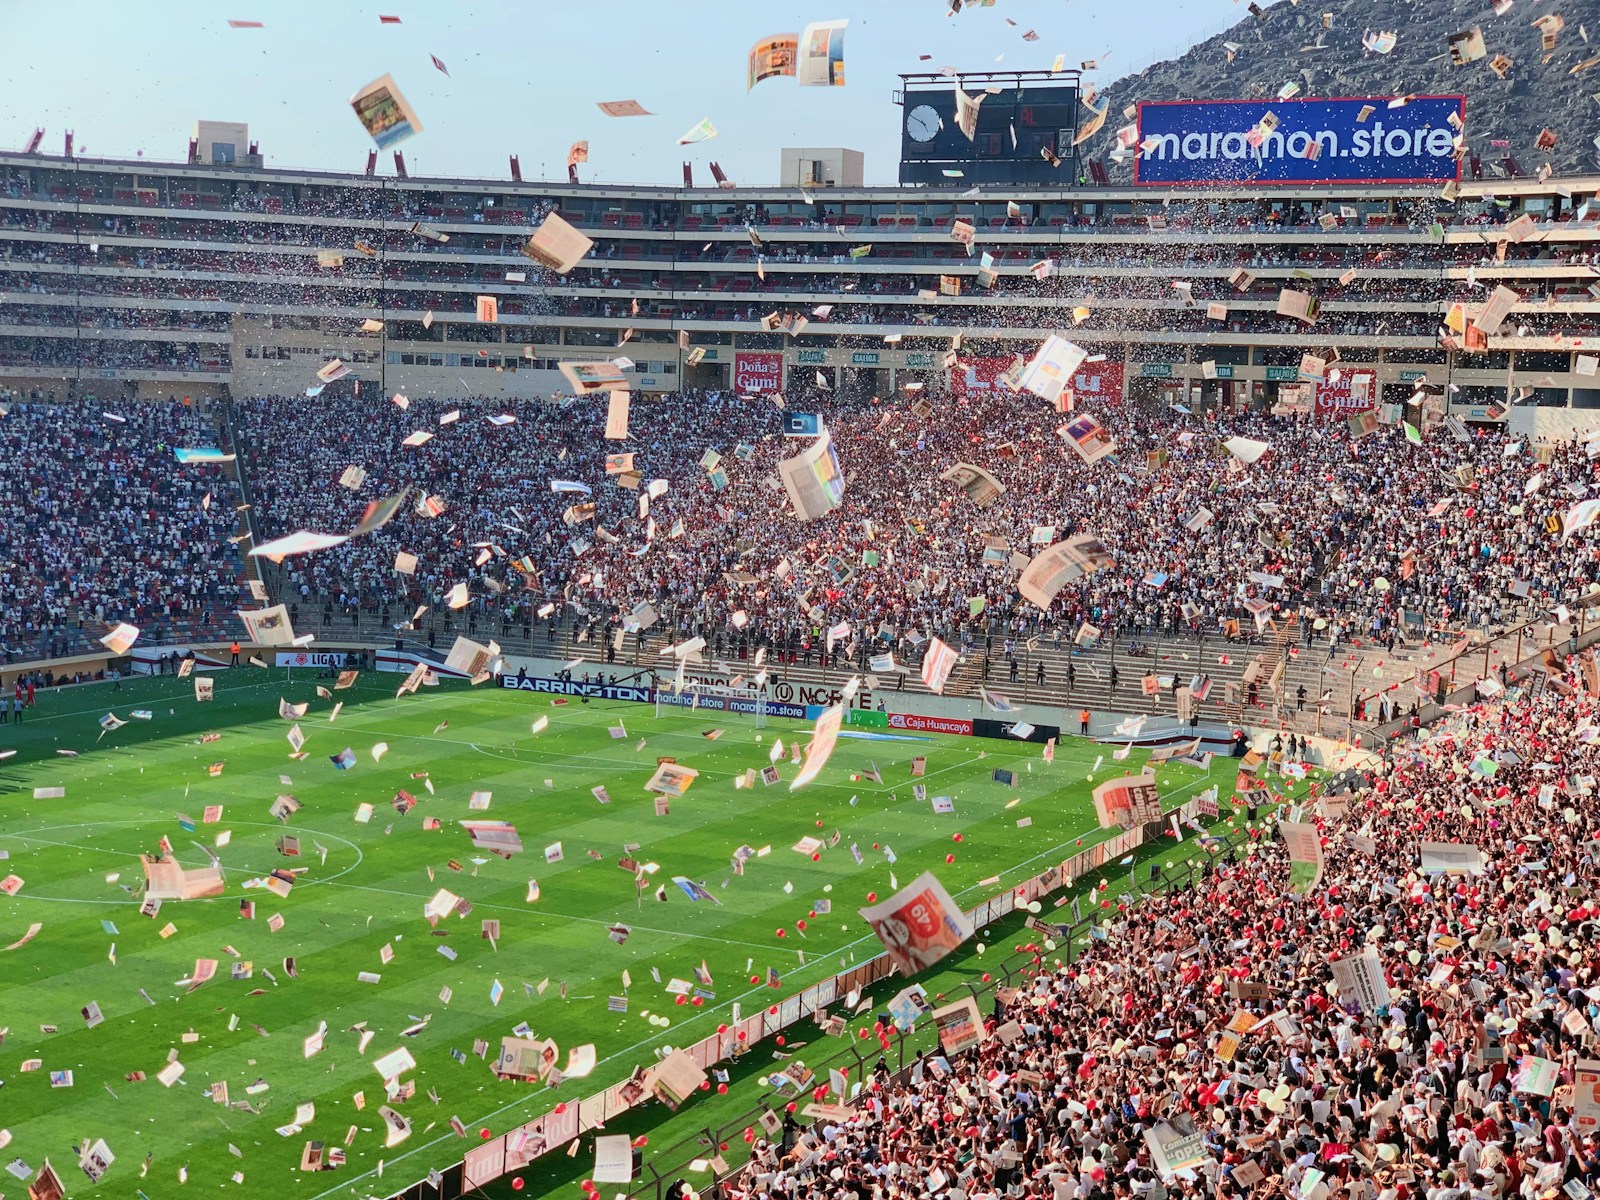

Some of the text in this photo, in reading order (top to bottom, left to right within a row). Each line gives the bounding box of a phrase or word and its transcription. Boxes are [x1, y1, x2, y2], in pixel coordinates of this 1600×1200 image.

[1143, 121, 1453, 161] marahon.store
[739, 360, 768, 372] Doña
[854, 354, 877, 362] SALIDA
[737, 374, 777, 389] Gumi
[503, 676, 649, 702] BARRINGTON
[799, 687, 872, 709] NORTE
[906, 718, 970, 735] Caja Huancayo
[1162, 1132, 1200, 1152] Comizzo
